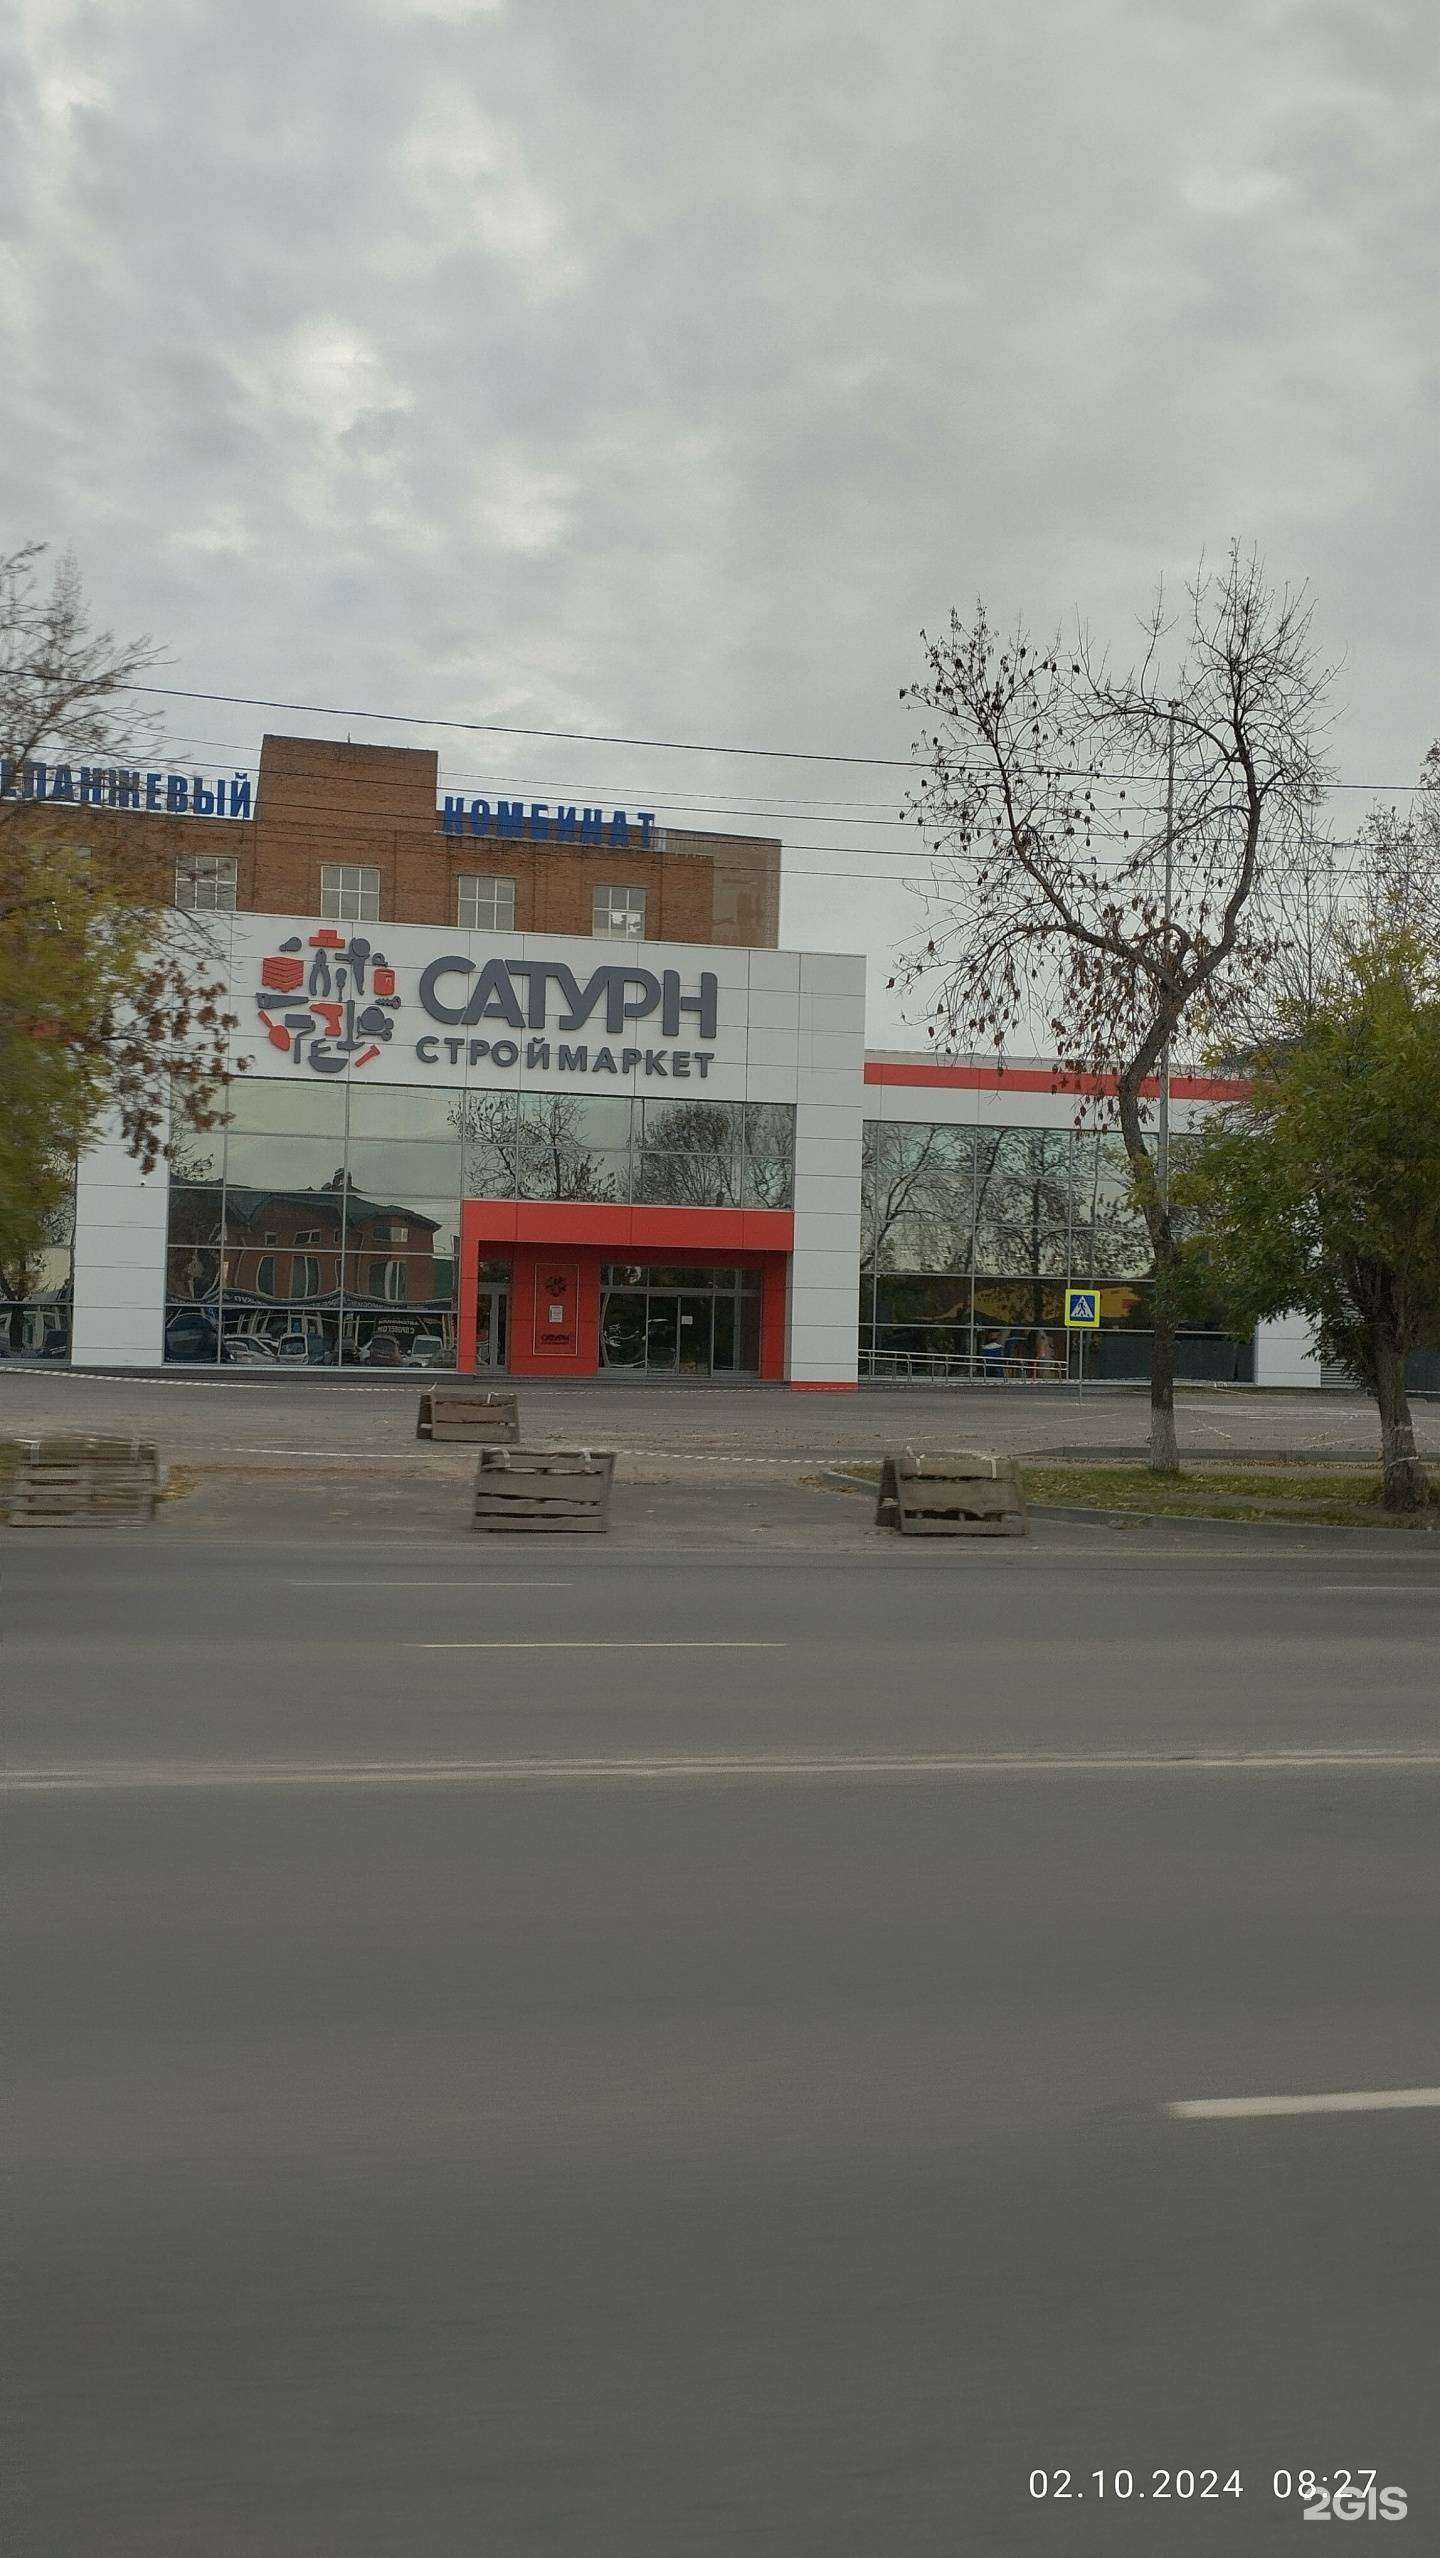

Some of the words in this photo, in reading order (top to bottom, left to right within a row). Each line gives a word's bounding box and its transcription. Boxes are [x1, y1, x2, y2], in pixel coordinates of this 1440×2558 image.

[443, 795, 656, 849] КОМБИНАТ
[418, 955, 718, 1039] САТУРН
[415, 1035, 716, 1078] СТРОЙМАРКЕТ
